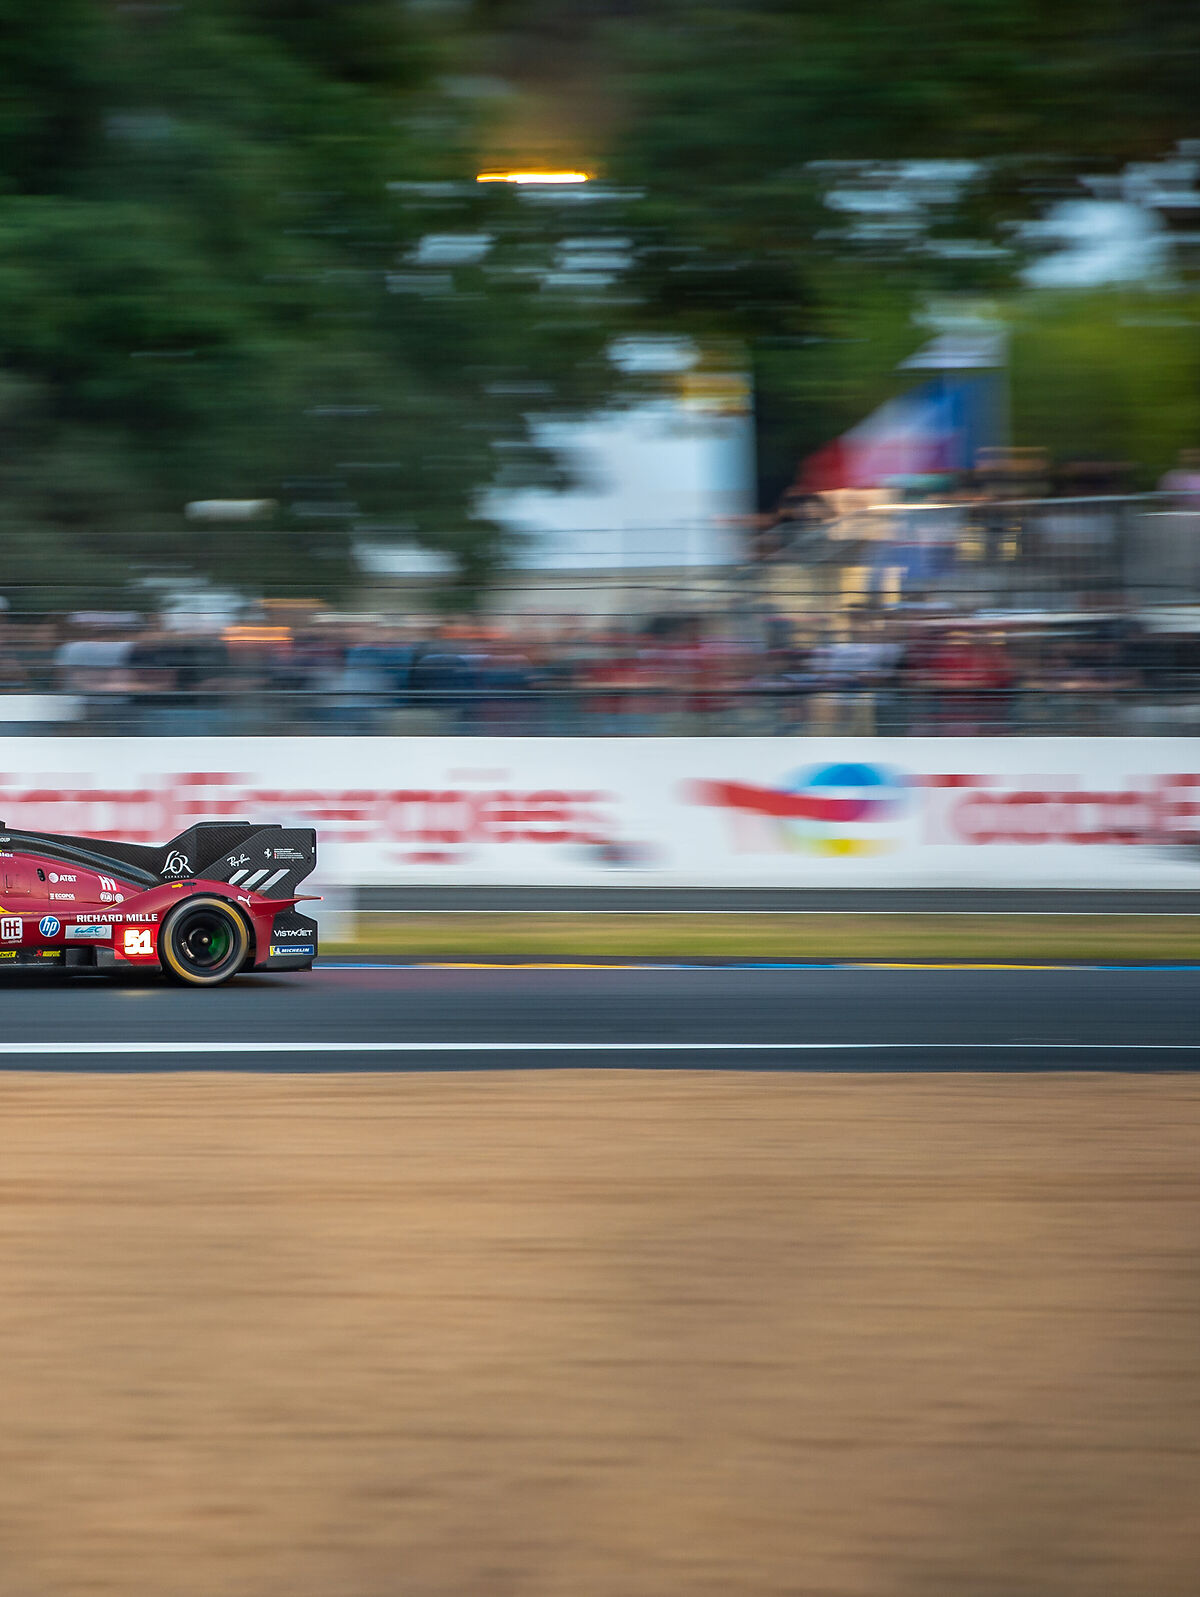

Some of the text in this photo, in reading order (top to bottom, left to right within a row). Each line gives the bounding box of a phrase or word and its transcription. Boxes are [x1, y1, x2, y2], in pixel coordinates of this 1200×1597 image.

[60, 874, 77, 882] AT&T
[76, 913, 158, 923] RICHARD MILLE
[41, 916, 58, 937] hp
[124, 929, 154, 955] 51
